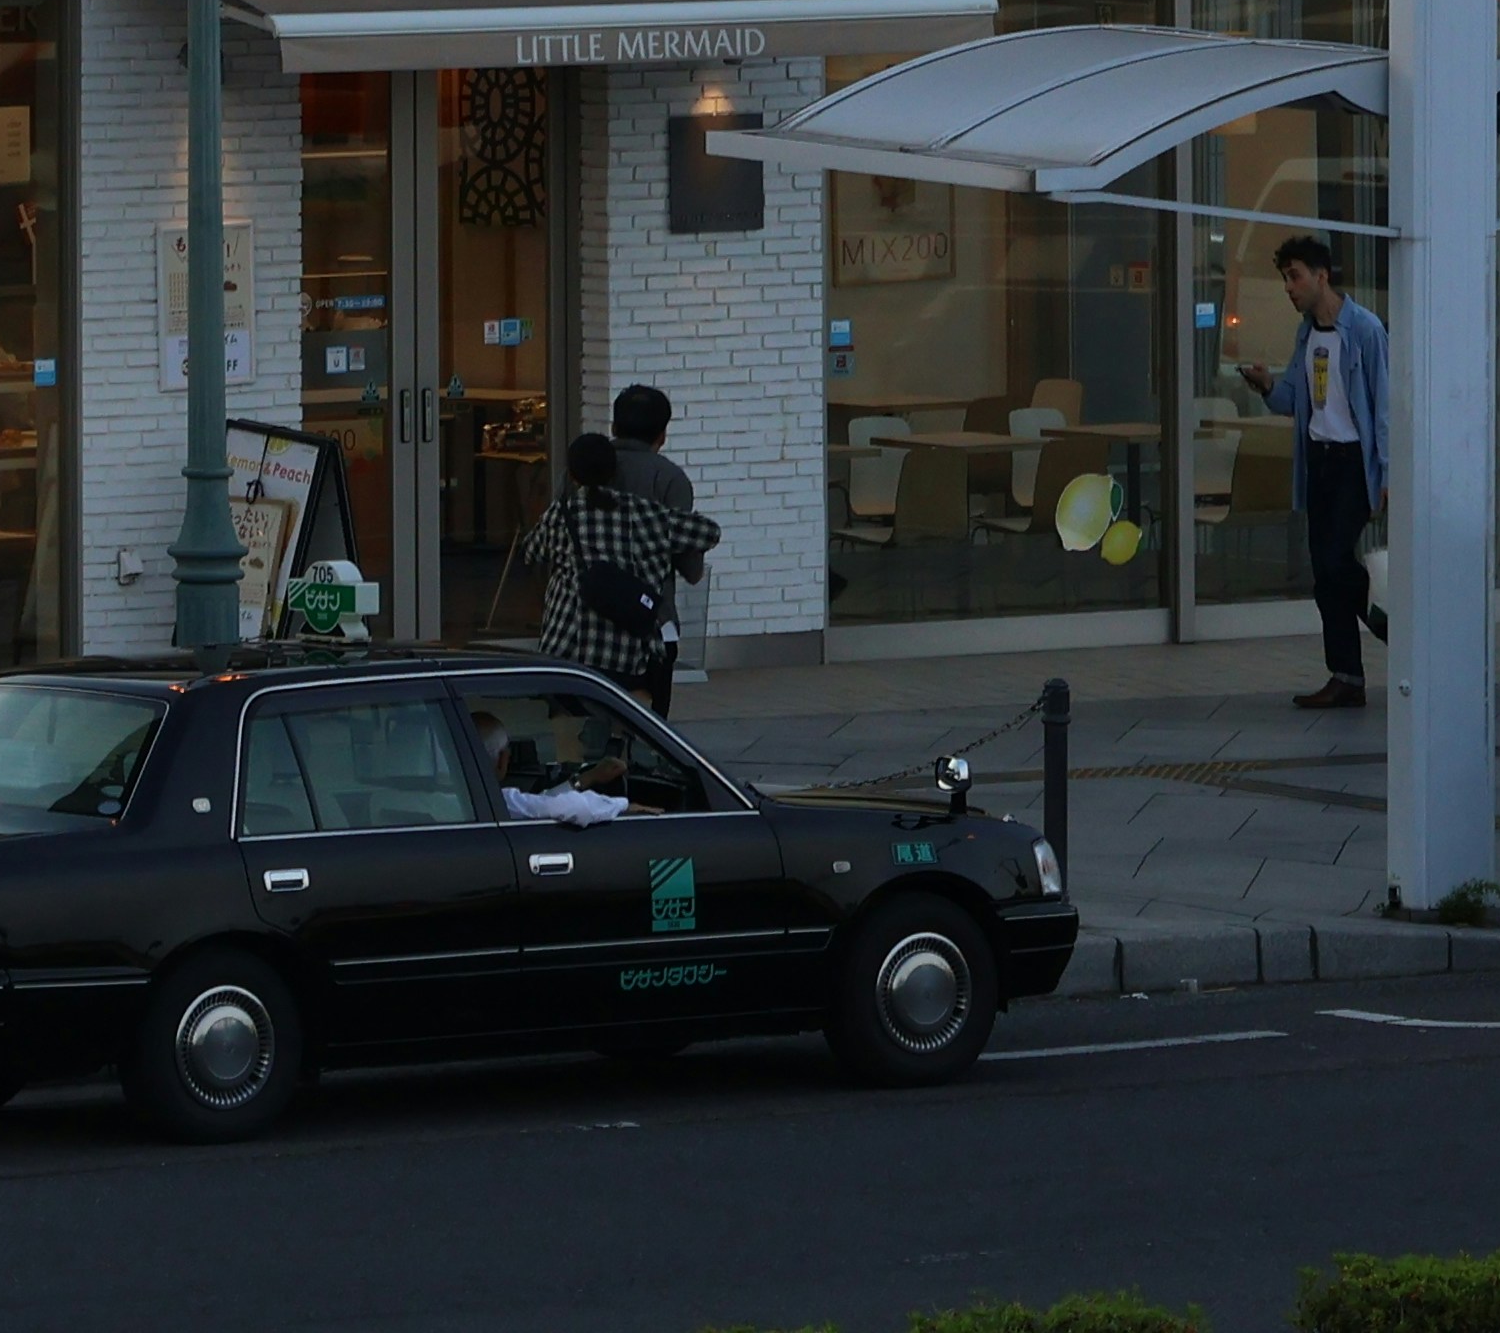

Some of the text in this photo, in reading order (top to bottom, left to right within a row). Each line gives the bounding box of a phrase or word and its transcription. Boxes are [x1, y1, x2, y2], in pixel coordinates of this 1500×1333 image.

[515, 26, 766, 66] LITTLE MERMAID
[842, 233, 947, 265] MIX200
[273, 462, 311, 484] Peach
[313, 566, 334, 583] 705
[305, 589, 341, 611] ビサン
[652, 897, 695, 920] ビサン
[620, 963, 727, 991] ビサンタクシー
